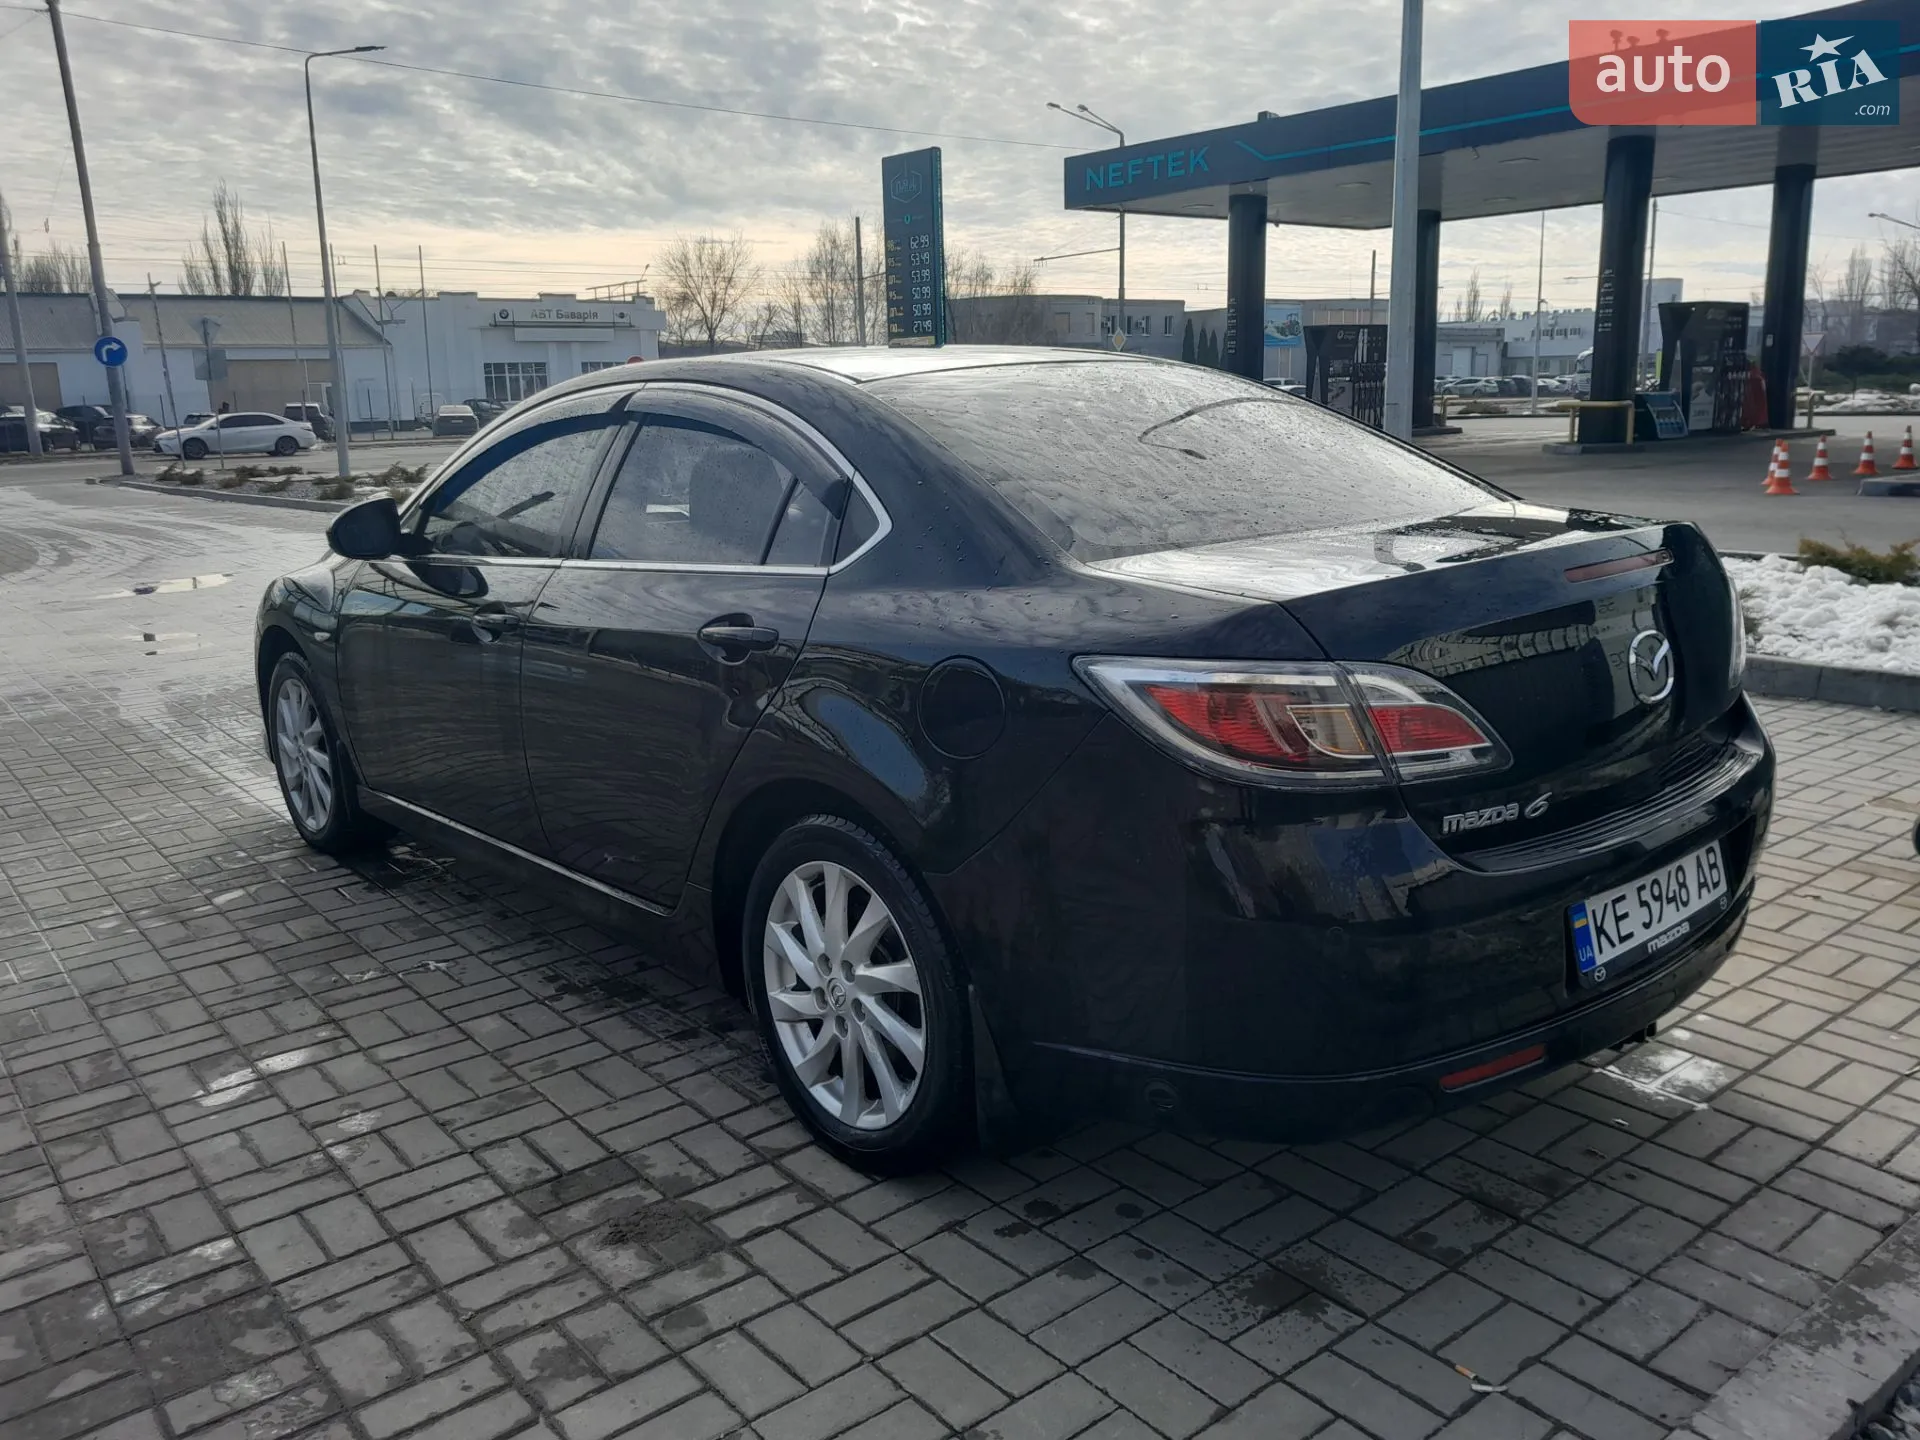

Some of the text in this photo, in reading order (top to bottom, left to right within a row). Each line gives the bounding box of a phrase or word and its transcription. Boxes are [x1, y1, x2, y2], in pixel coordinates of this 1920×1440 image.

[1085, 146, 1209, 191] NEFTEK
[1442, 791, 1553, 835] mazda 6
[1591, 845, 1722, 956] KE 5948 AB
[1578, 949, 1594, 962] UA
[1647, 920, 1691, 954] mazda
